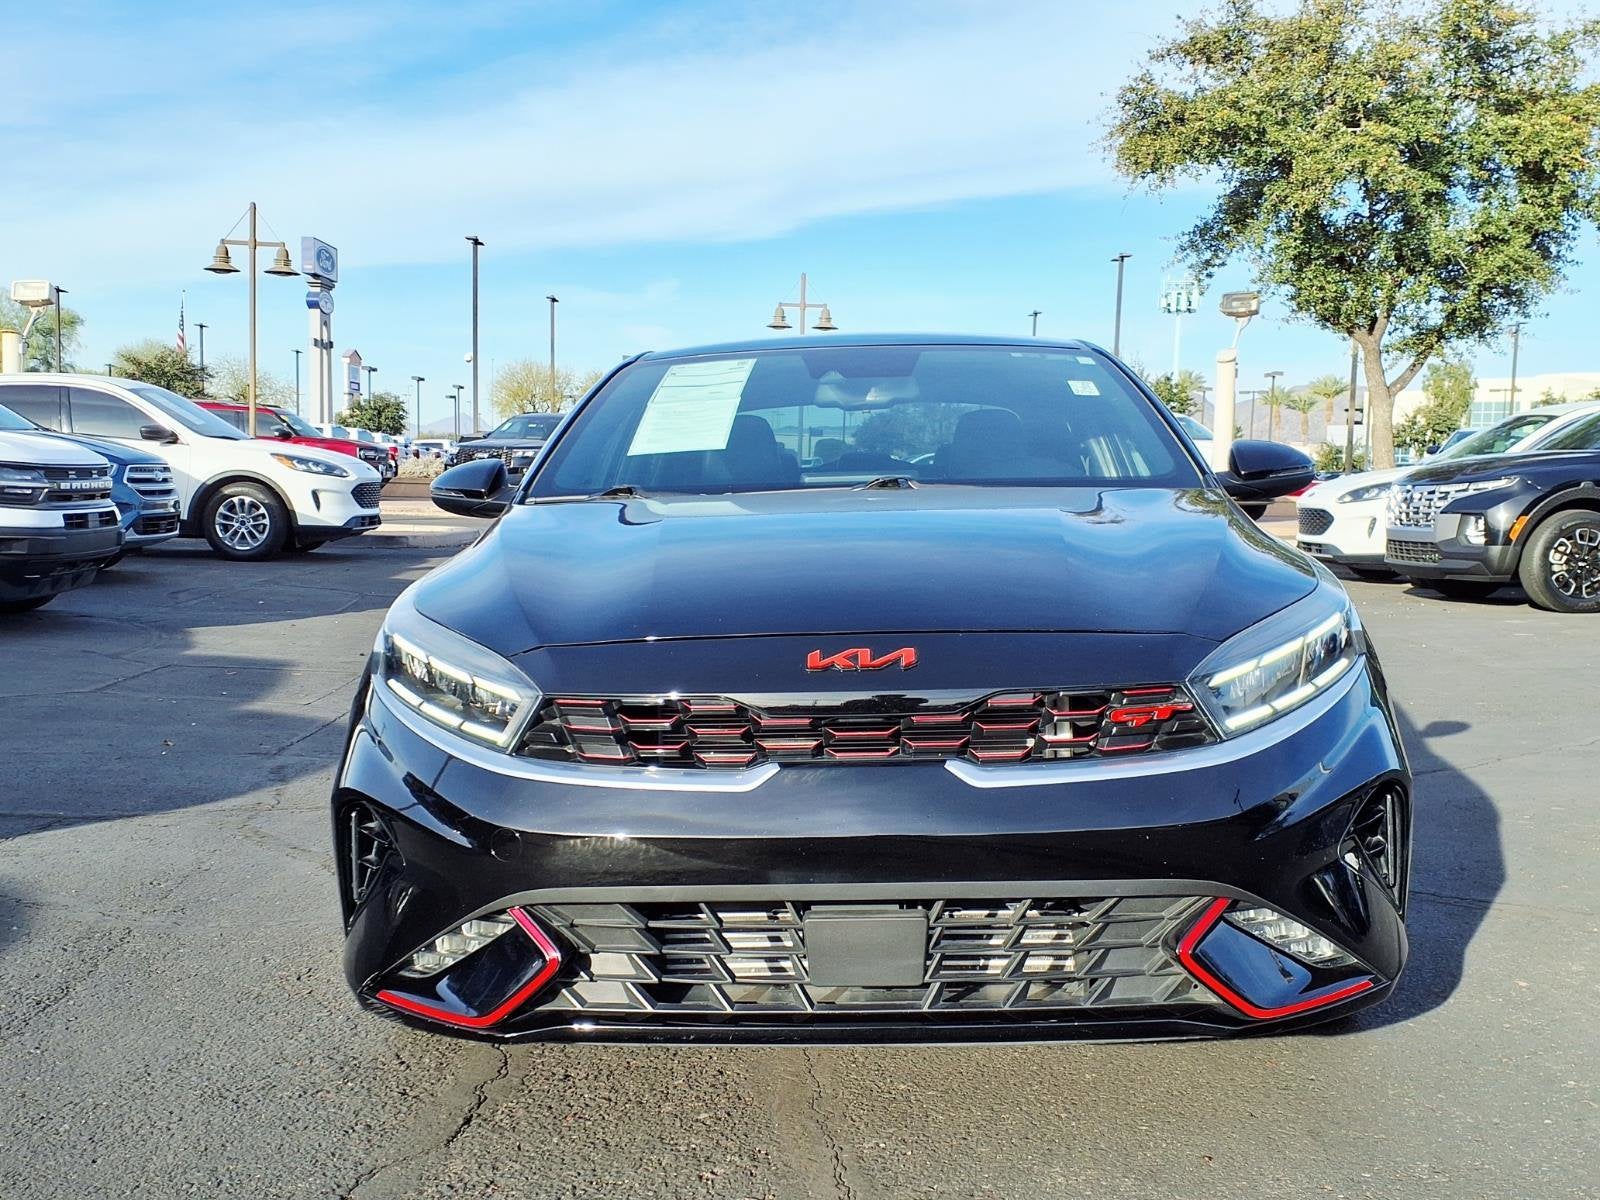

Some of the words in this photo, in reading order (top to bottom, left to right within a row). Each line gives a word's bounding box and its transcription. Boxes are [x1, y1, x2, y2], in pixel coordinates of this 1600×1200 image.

[60, 481, 113, 490] BRONCO
[806, 647, 918, 672] KIA
[1110, 702, 1194, 727] GT
